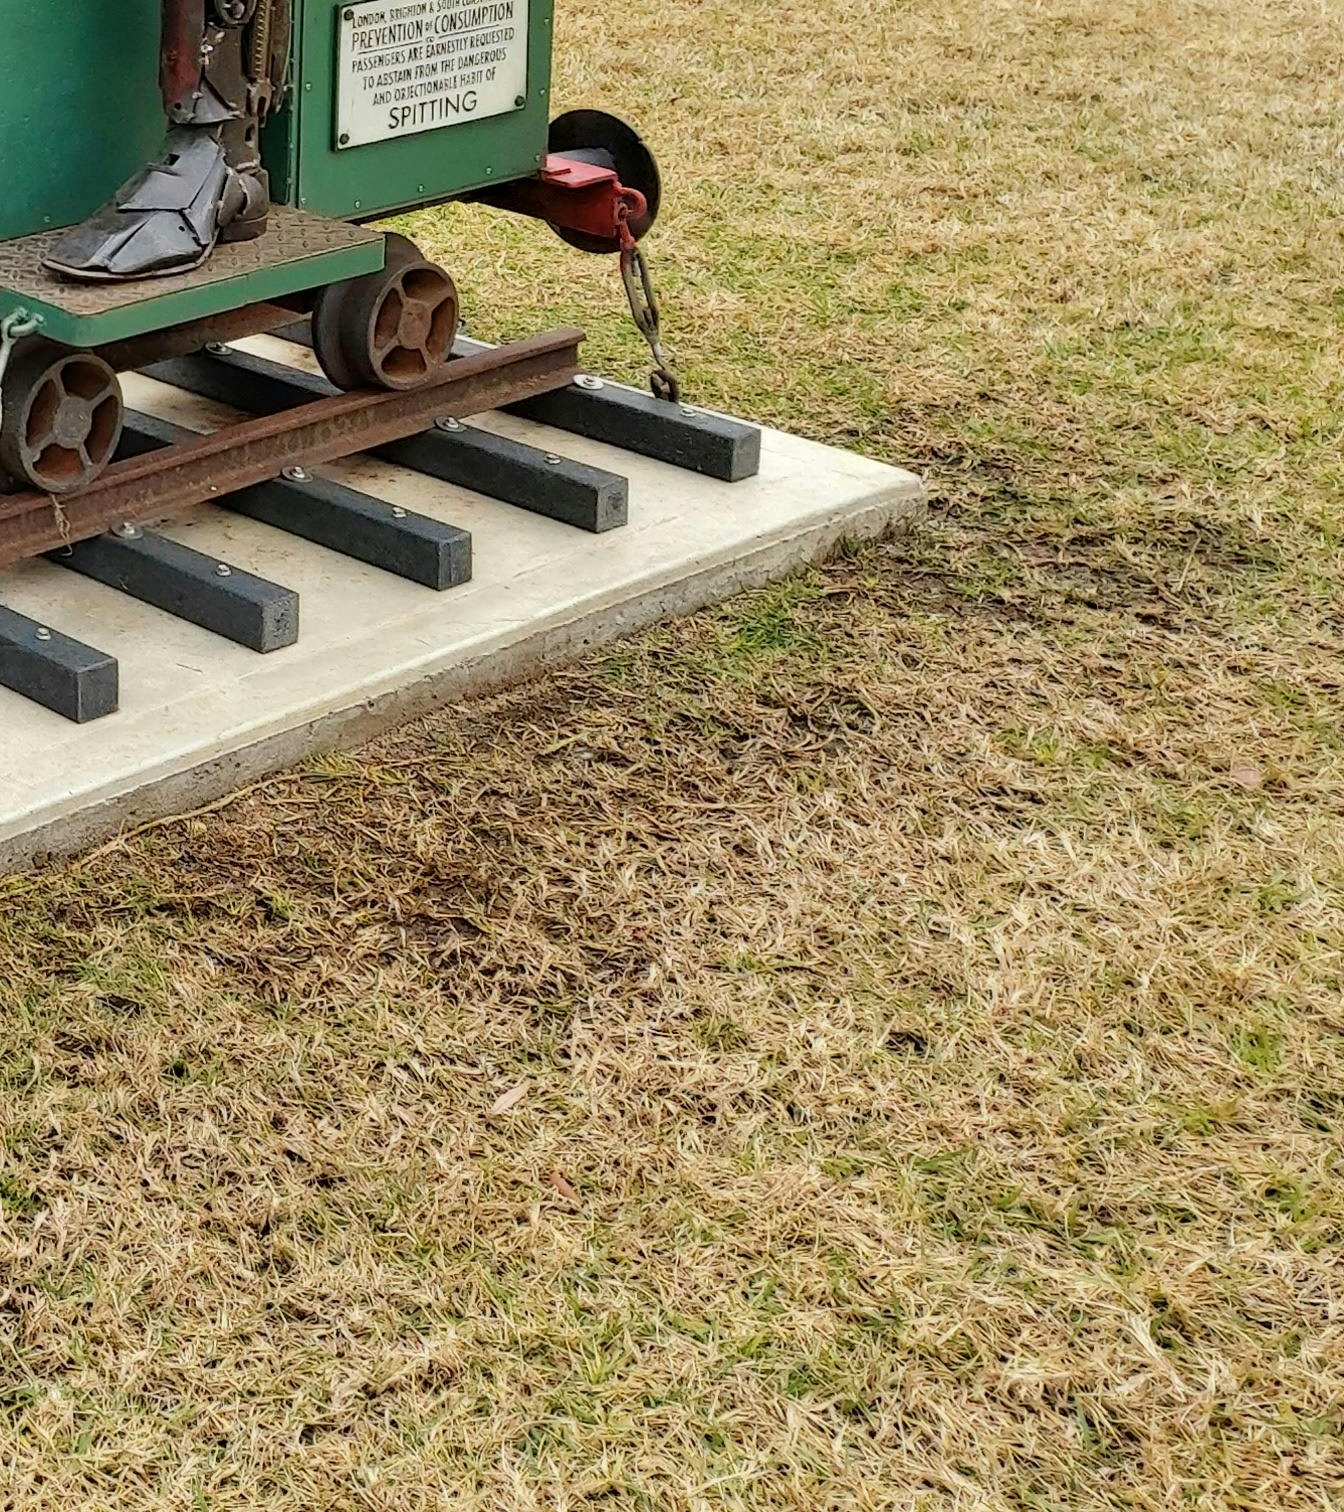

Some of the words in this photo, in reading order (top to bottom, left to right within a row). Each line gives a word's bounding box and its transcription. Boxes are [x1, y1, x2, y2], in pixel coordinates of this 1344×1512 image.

[352, 20, 423, 51] PREVENTION
[434, 1, 514, 33] CONSUMPTION
[390, 2, 427, 21] BRIGHTON
[430, 1, 435, 13] &
[352, 50, 406, 72] PASSENGERS
[407, 46, 423, 62] ARE
[426, 37, 469, 58] EARNESTLY
[470, 27, 515, 48] REQUESTED
[363, 76, 374, 90] TO
[376, 68, 412, 87] ABSTAIN
[414, 62, 438, 79] FROM
[441, 58, 455, 72] THE
[458, 47, 508, 70] DANGEROUS
[373, 90, 392, 105] AND
[394, 75, 457, 101] OBJECTIONABLE
[460, 70, 483, 87] HABIT
[485, 66, 497, 81] OF
[388, 90, 477, 129] SPITTING
